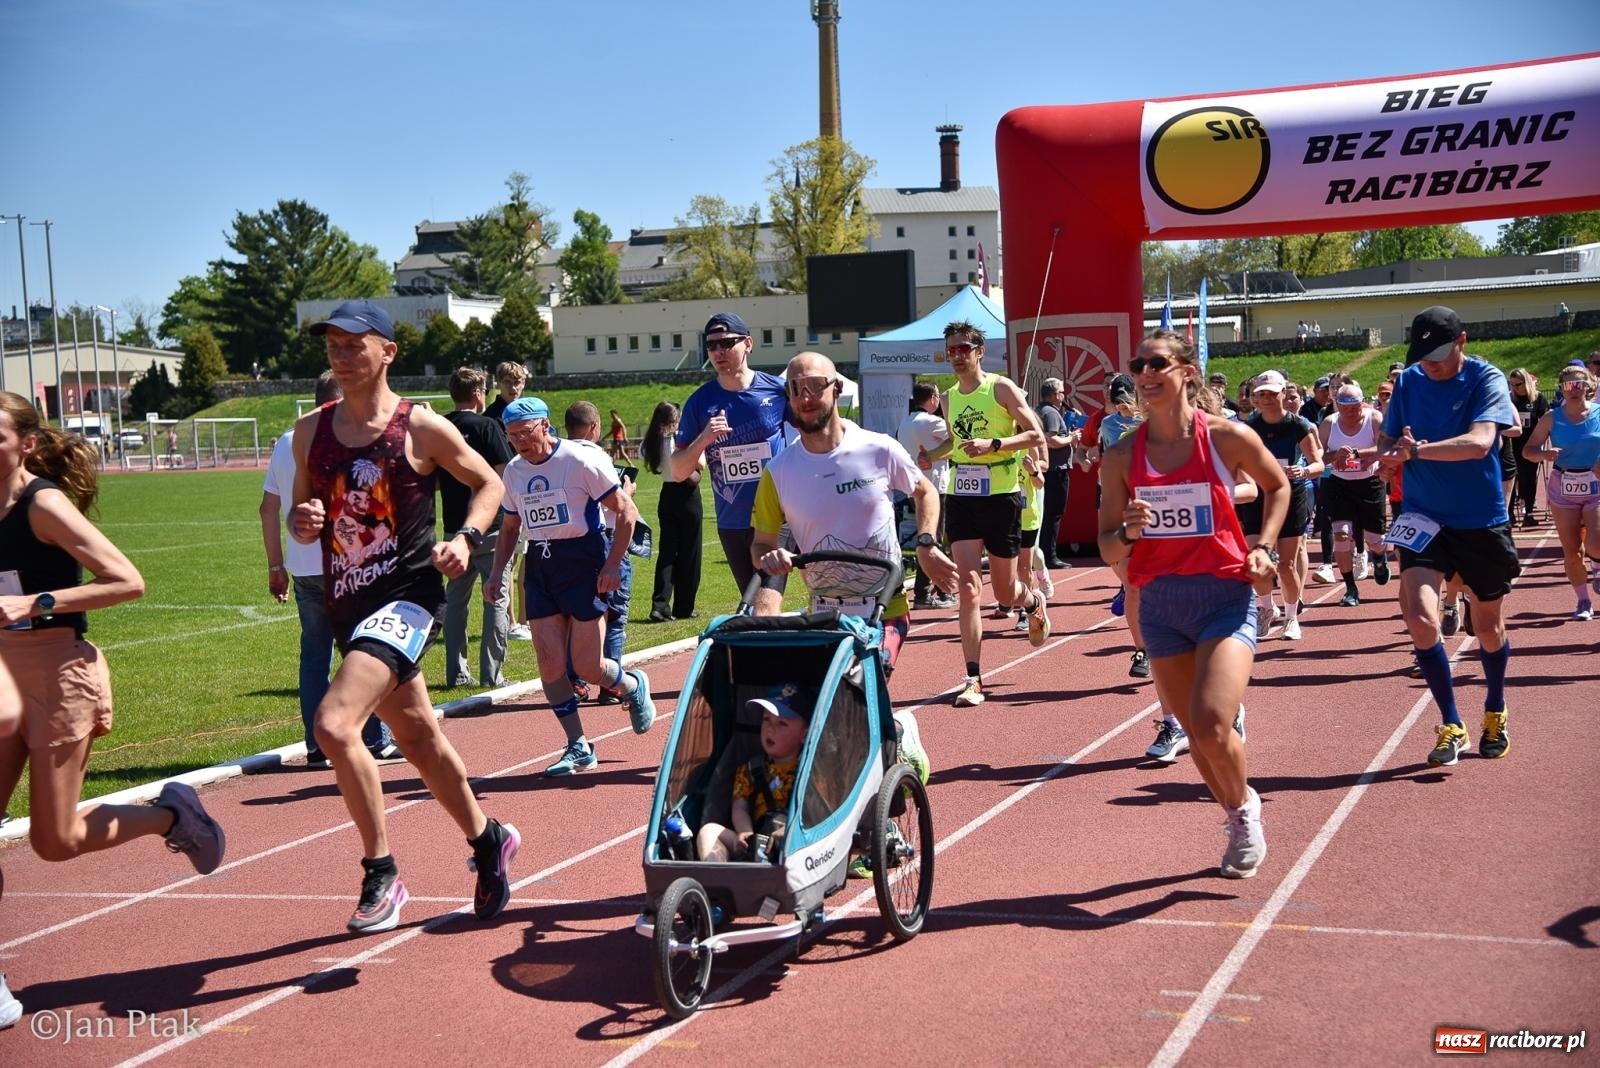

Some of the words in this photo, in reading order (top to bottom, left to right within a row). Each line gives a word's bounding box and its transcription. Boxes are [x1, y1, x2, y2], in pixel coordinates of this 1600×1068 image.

[1380, 81, 1492, 113] BIEG
[1205, 118, 1268, 142] SIR
[1302, 129, 1393, 164] BEZ
[1400, 111, 1576, 156] GRANIC
[1325, 160, 1551, 205] RACIBÓRZ
[870, 353, 930, 363] PersonalBest
[728, 461, 759, 477] 065
[836, 478, 862, 494] UTA
[957, 479, 979, 490] 069
[1565, 483, 1588, 492] 070
[529, 506, 556, 523] 052
[1149, 508, 1192, 529] 058
[1391, 524, 1416, 540] 079
[364, 617, 409, 640] 053
